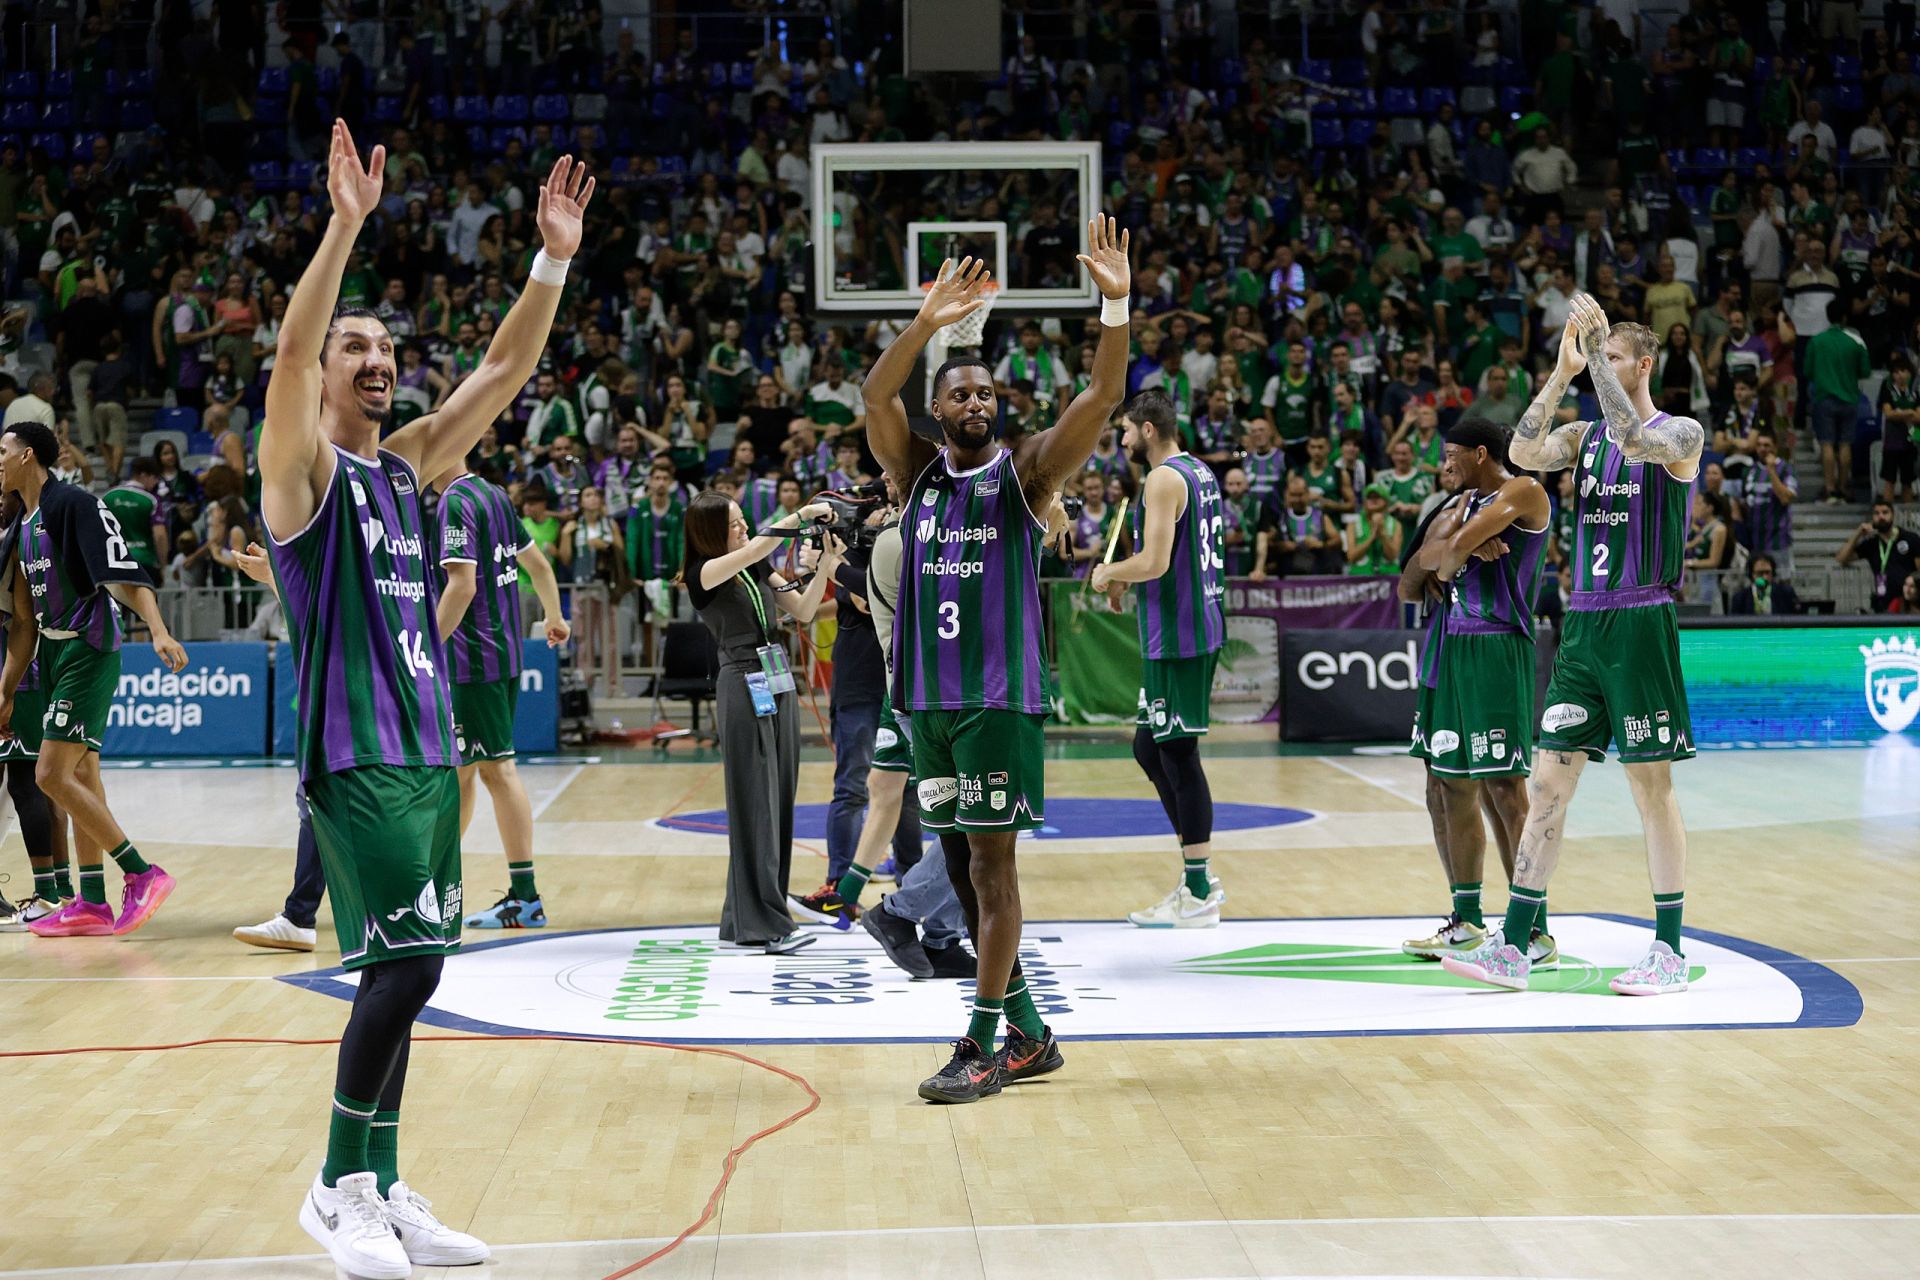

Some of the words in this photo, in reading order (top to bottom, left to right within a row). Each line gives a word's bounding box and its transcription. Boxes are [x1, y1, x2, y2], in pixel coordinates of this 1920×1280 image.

[1595, 480, 1641, 498] Uncaja
[936, 523, 998, 545] Unicaja
[1199, 515, 1224, 572] 33
[921, 556, 984, 579] málaga
[1592, 543, 1610, 577] 2
[937, 600, 961, 640] 3
[397, 629, 435, 678] 14
[1298, 639, 1419, 691] end
[113, 666, 251, 698] ndación
[106, 697, 203, 736] nicaja
